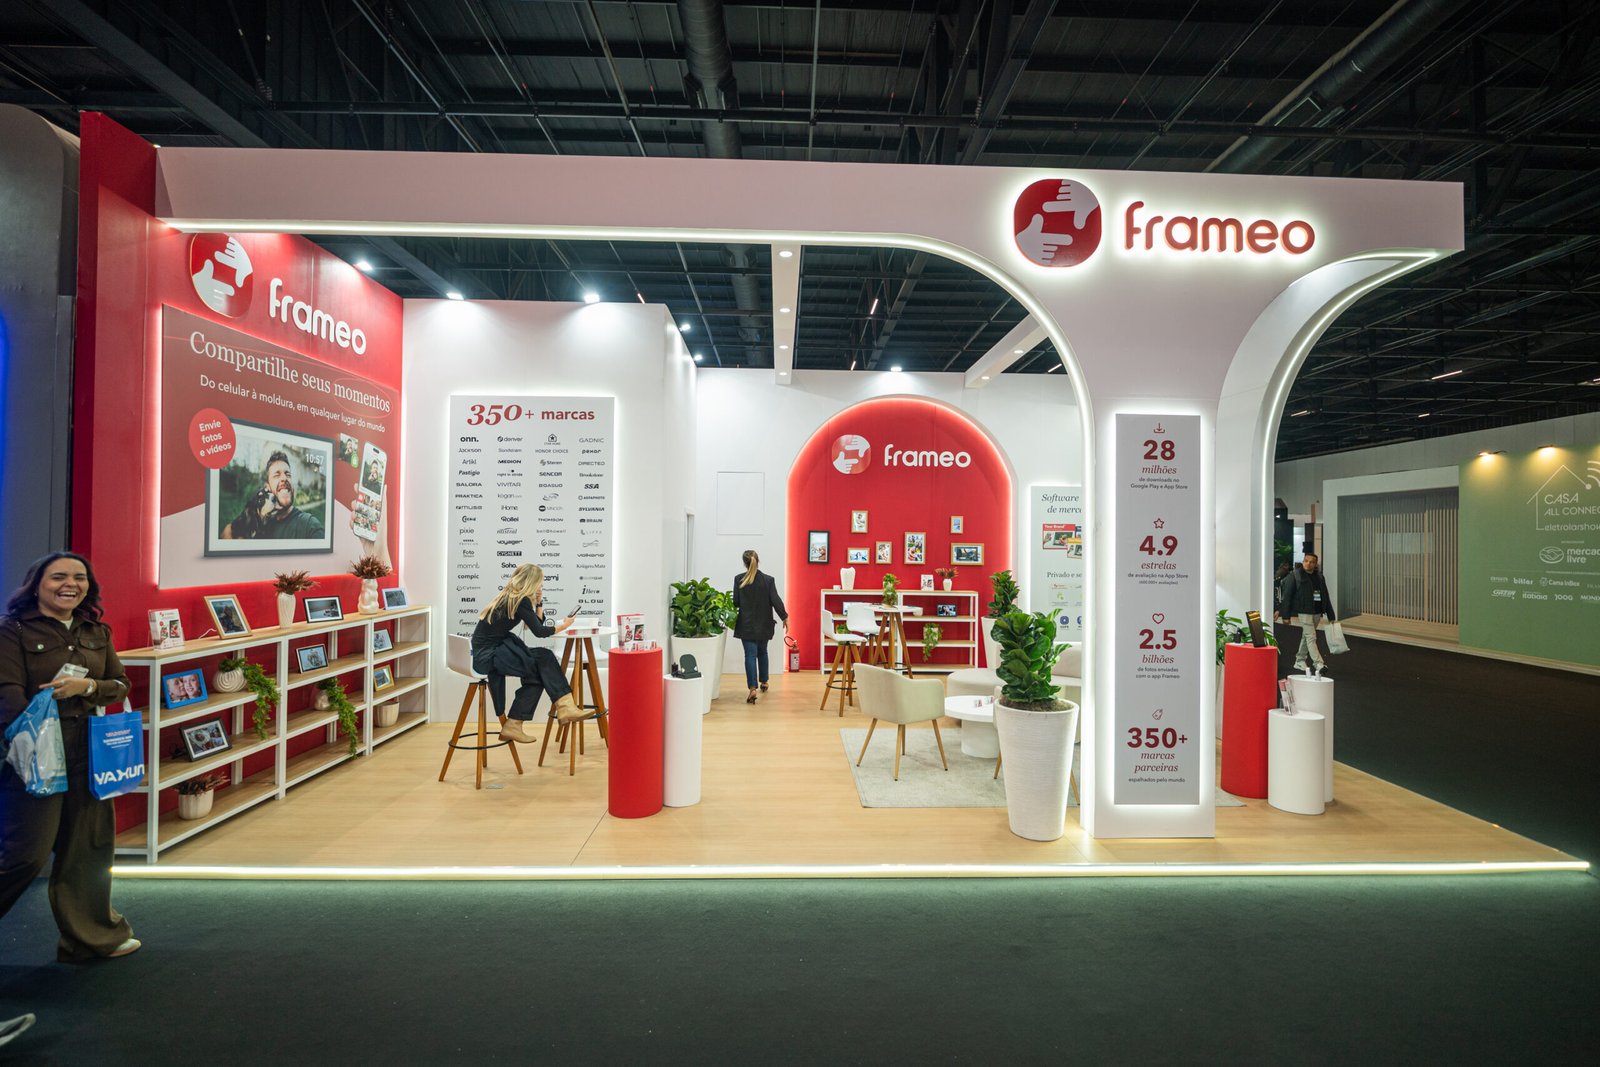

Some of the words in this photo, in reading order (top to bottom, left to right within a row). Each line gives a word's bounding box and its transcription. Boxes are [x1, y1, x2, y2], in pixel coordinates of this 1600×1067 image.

[1125, 201, 1315, 254] frameo
[269, 278, 366, 354] frameo
[190, 331, 298, 384] Compartilhe
[302, 373, 331, 393] seus
[334, 382, 390, 412] momentos
[200, 375, 216, 389] Do
[218, 380, 250, 397] celular
[252, 388, 257, 399] à
[259, 392, 295, 411] moldura,
[297, 402, 308, 412] em
[310, 405, 340, 421] qualquer
[341, 413, 357, 426] lugar
[358, 418, 366, 427] do
[367, 420, 385, 432] mundo
[467, 404, 534, 425] 350+
[541, 411, 595, 420] marcas
[199, 420, 221, 431] Envie
[202, 432, 222, 443] fotos
[206, 441, 231, 455] vídeos
[1143, 440, 1175, 460] 28
[305, 453, 324, 465] 10:57
[884, 444, 971, 467] frameo
[1142, 465, 1177, 474] milhões
[1042, 493, 1079, 503] Software
[1544, 493, 1579, 504] CASA
[1047, 505, 1058, 513] de
[1544, 507, 1560, 516] ALL
[1139, 535, 1178, 555] 4.9
[1567, 555, 1587, 563] livre
[1141, 561, 1176, 570] estrelas
[1139, 629, 1177, 650] 2.5
[1142, 655, 1174, 663] bilhões
[1127, 727, 1188, 748] 350+
[1135, 763, 1178, 773] parceiras
